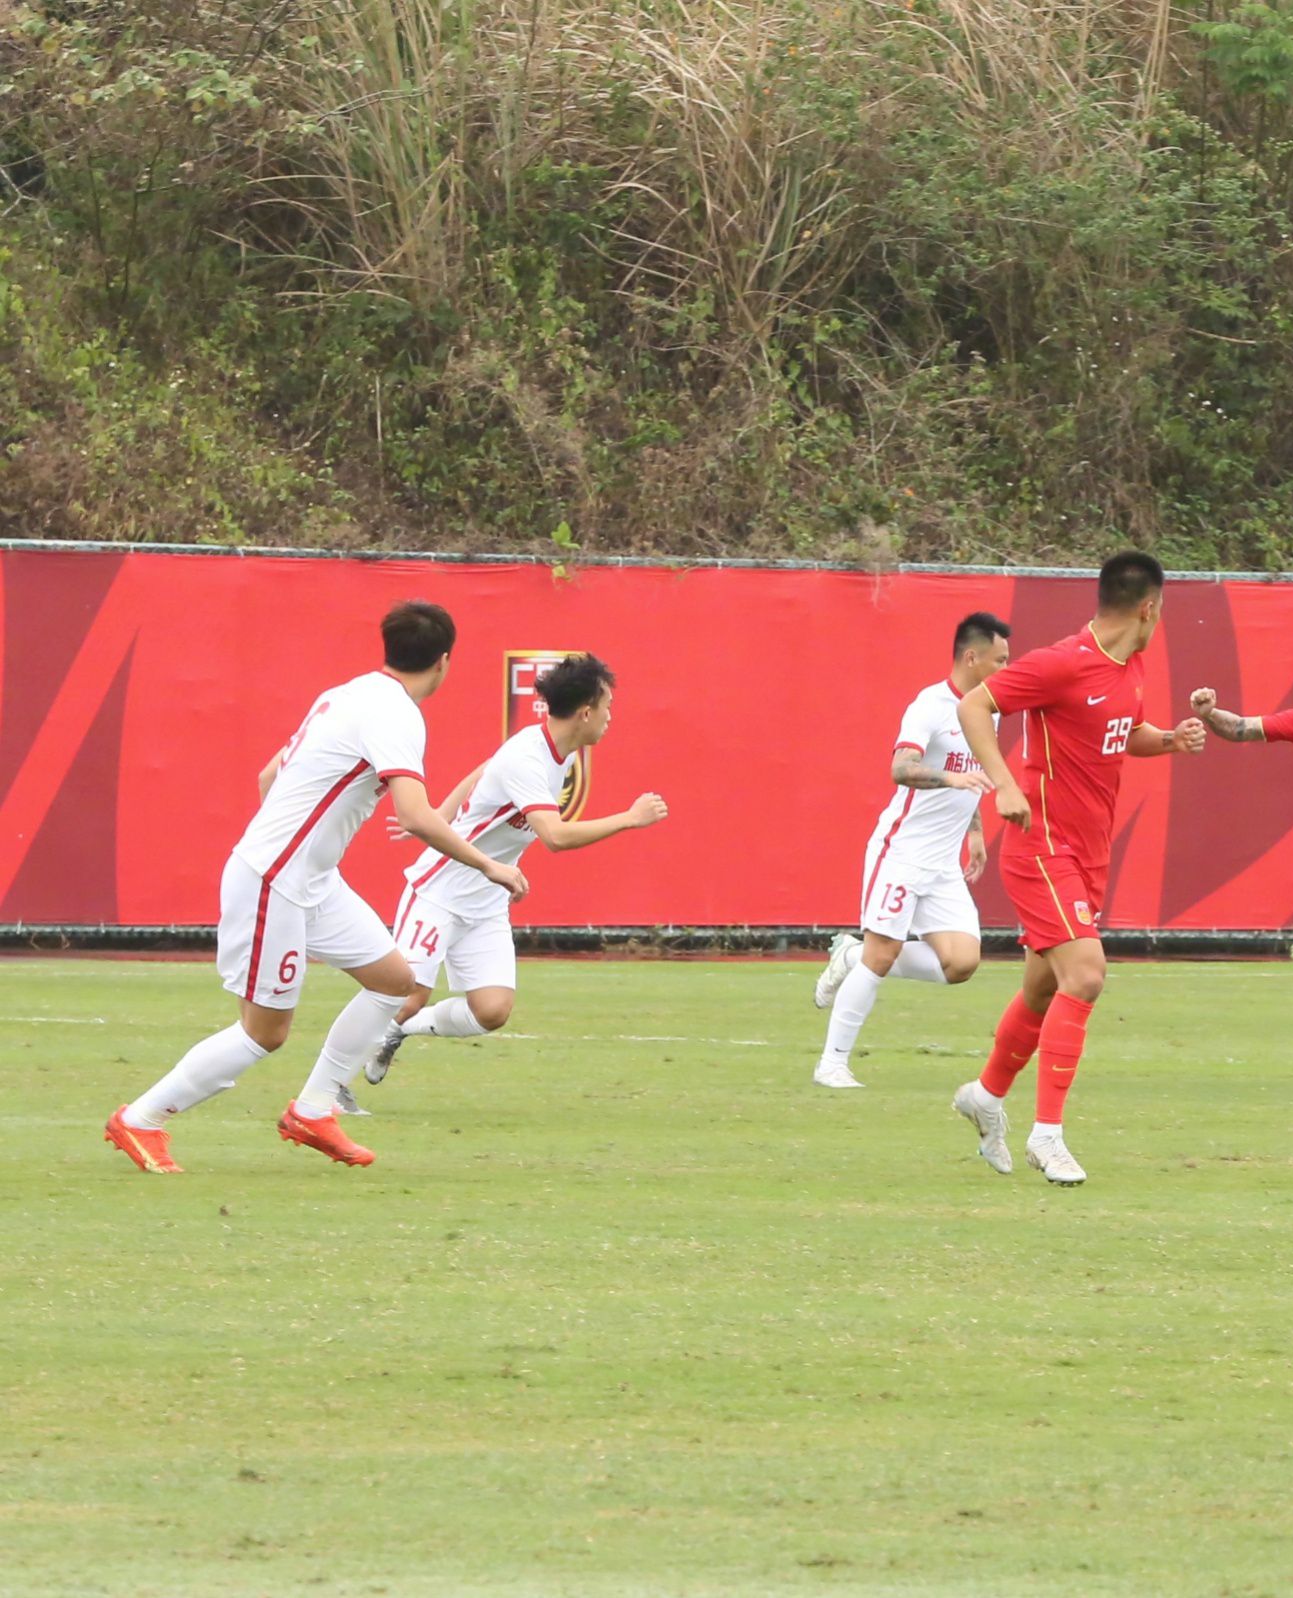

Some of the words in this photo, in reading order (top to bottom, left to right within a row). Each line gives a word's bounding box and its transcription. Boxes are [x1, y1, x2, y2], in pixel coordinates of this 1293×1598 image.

[1102, 716, 1133, 755] 29
[879, 883, 907, 914] 13
[409, 920, 439, 957] 14
[279, 950, 299, 984] 6
